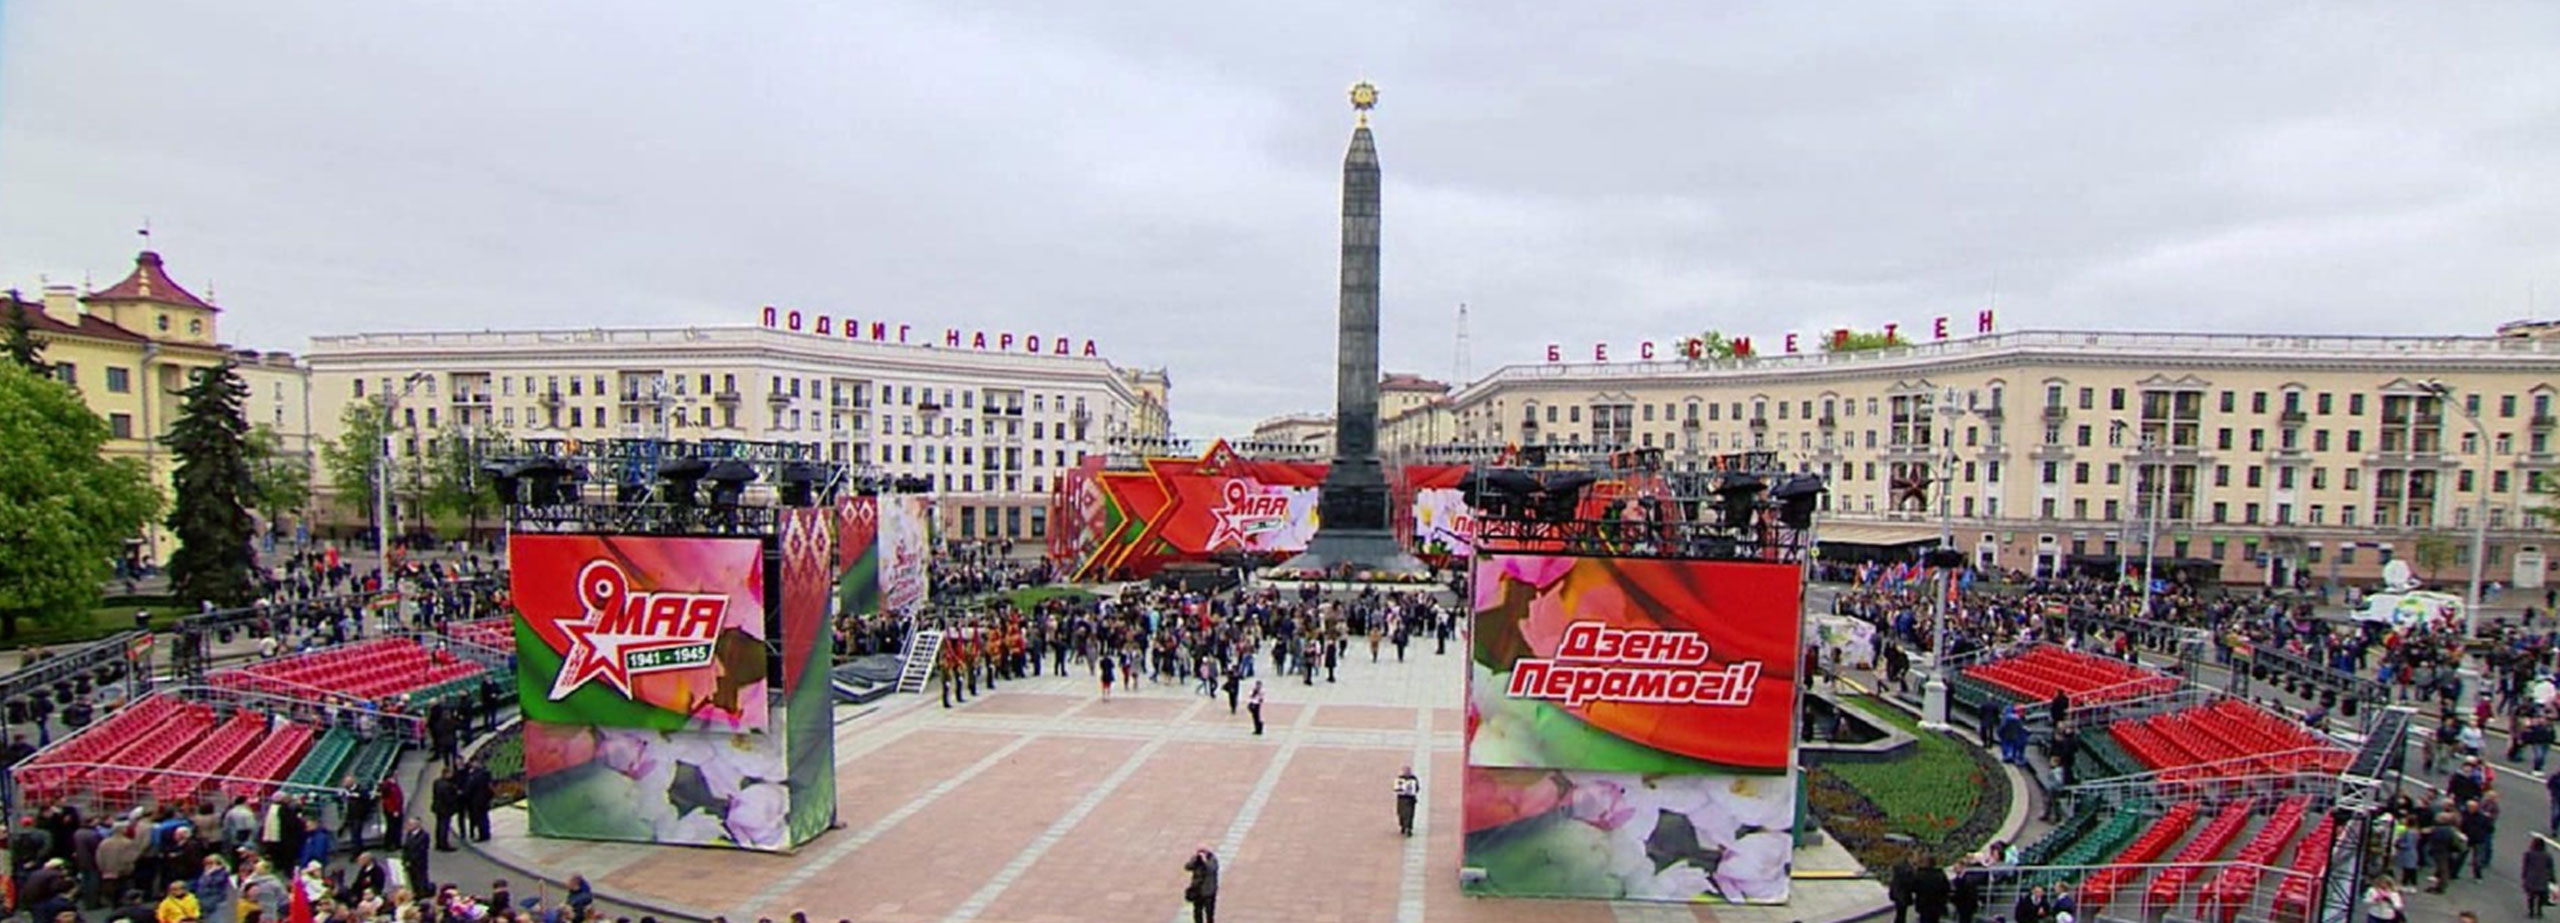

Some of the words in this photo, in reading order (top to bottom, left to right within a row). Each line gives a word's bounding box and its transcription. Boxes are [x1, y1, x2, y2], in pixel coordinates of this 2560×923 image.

[763, 307, 911, 343] ПОДВИГ
[946, 328, 1096, 357] НАРОДА
[1547, 310, 1993, 362] БЕССМЕРТЕН
[582, 563, 627, 635] 9
[606, 596, 726, 638] МАЯ
[630, 652, 661, 668] 1941
[674, 645, 707, 662] 1945
[1559, 624, 1707, 662] Дзень
[1510, 661, 1758, 705] Перамогі!
